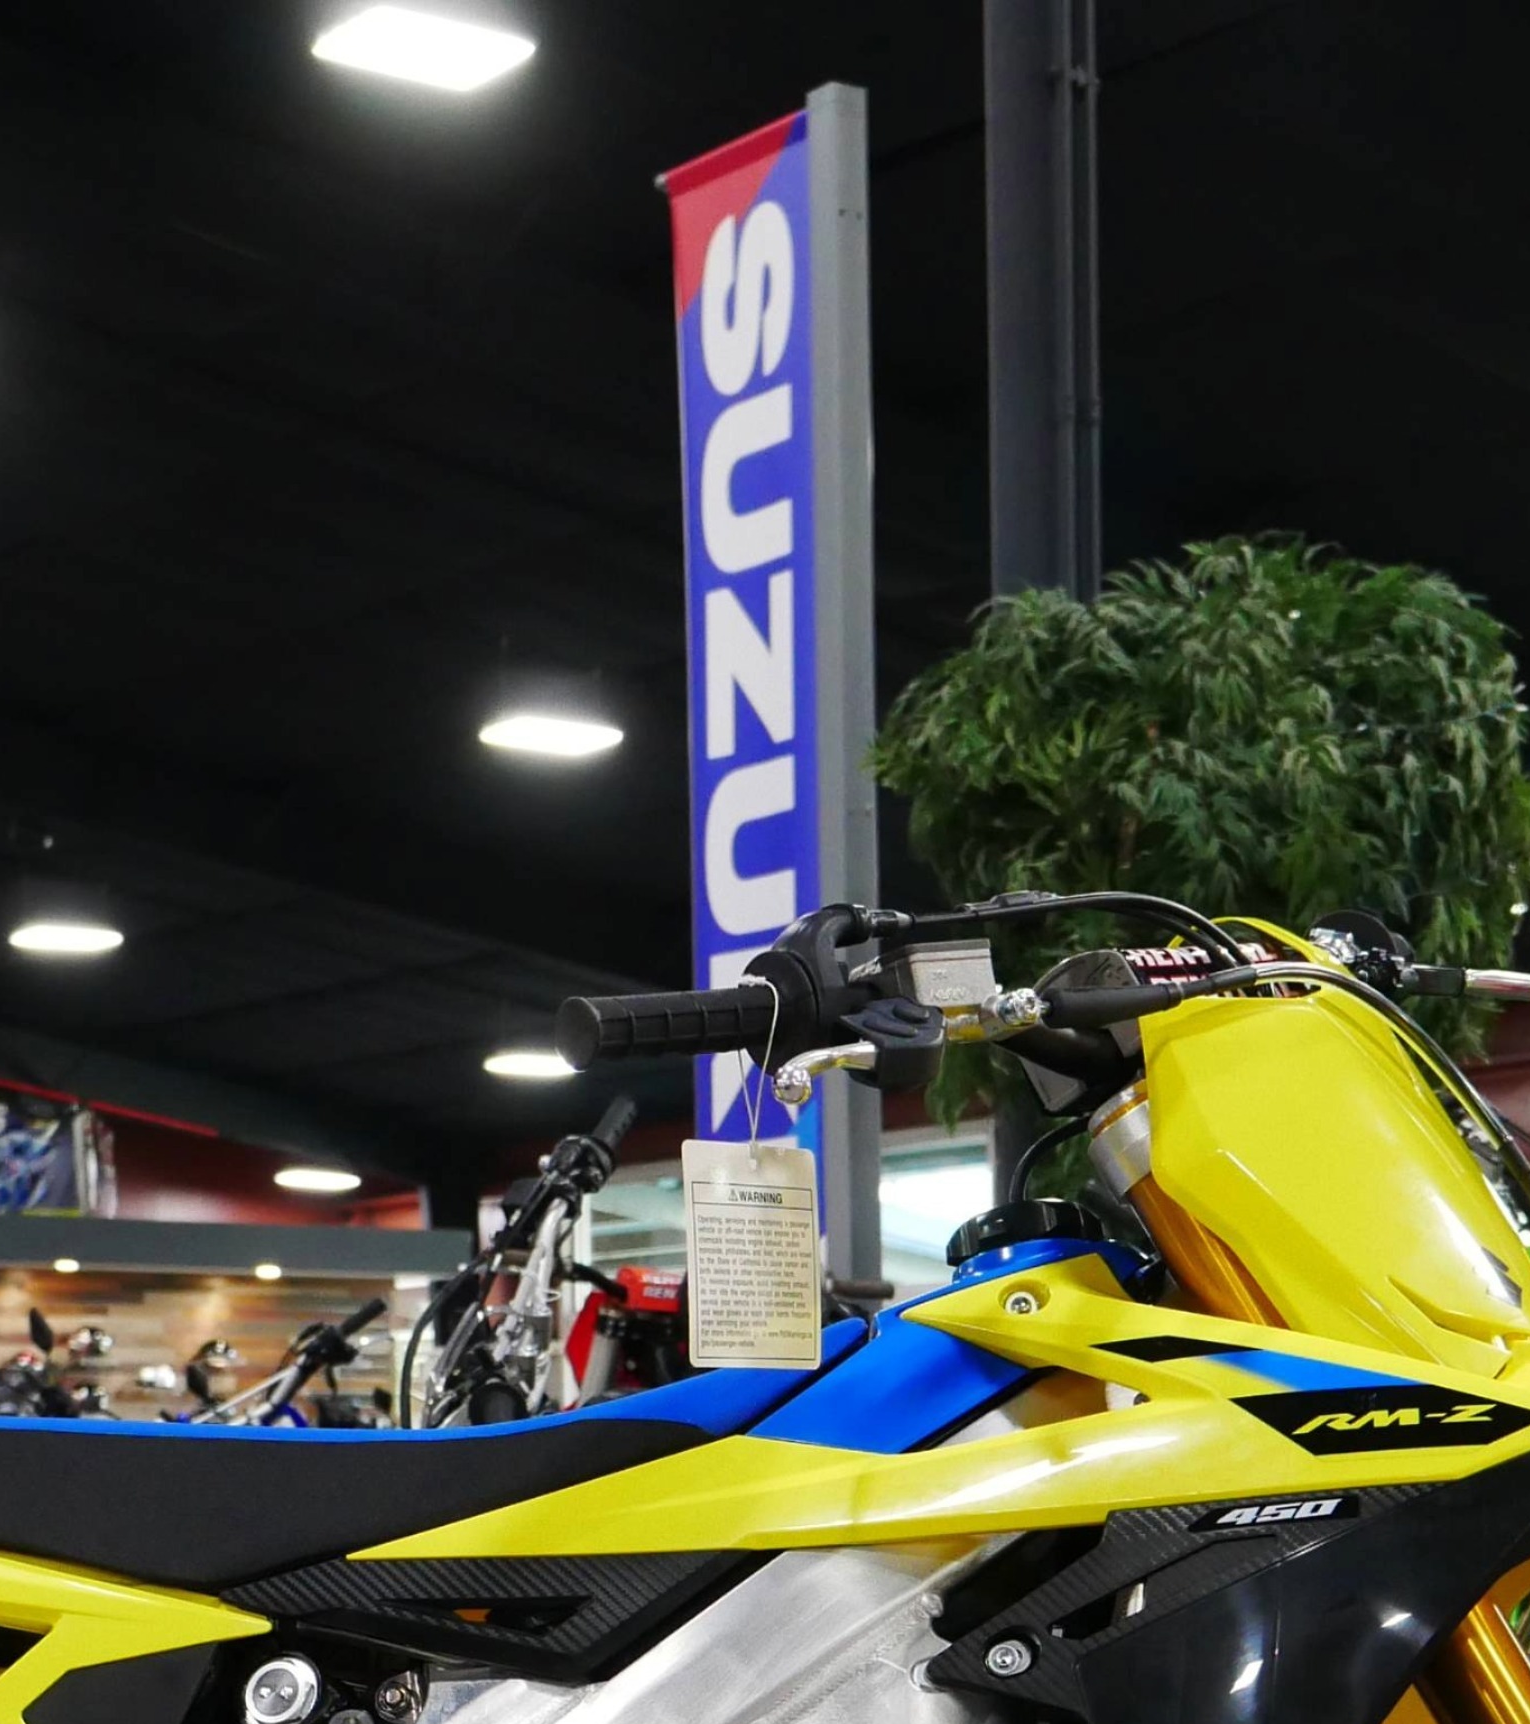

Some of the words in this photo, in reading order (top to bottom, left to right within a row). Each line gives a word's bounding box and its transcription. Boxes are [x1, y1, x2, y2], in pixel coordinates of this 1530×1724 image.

[700, 199, 798, 1147] SUZU
[738, 1191, 784, 1205] WARNING
[1292, 1403, 1499, 1437] RM-Z
[1216, 1498, 1343, 1527] 450
